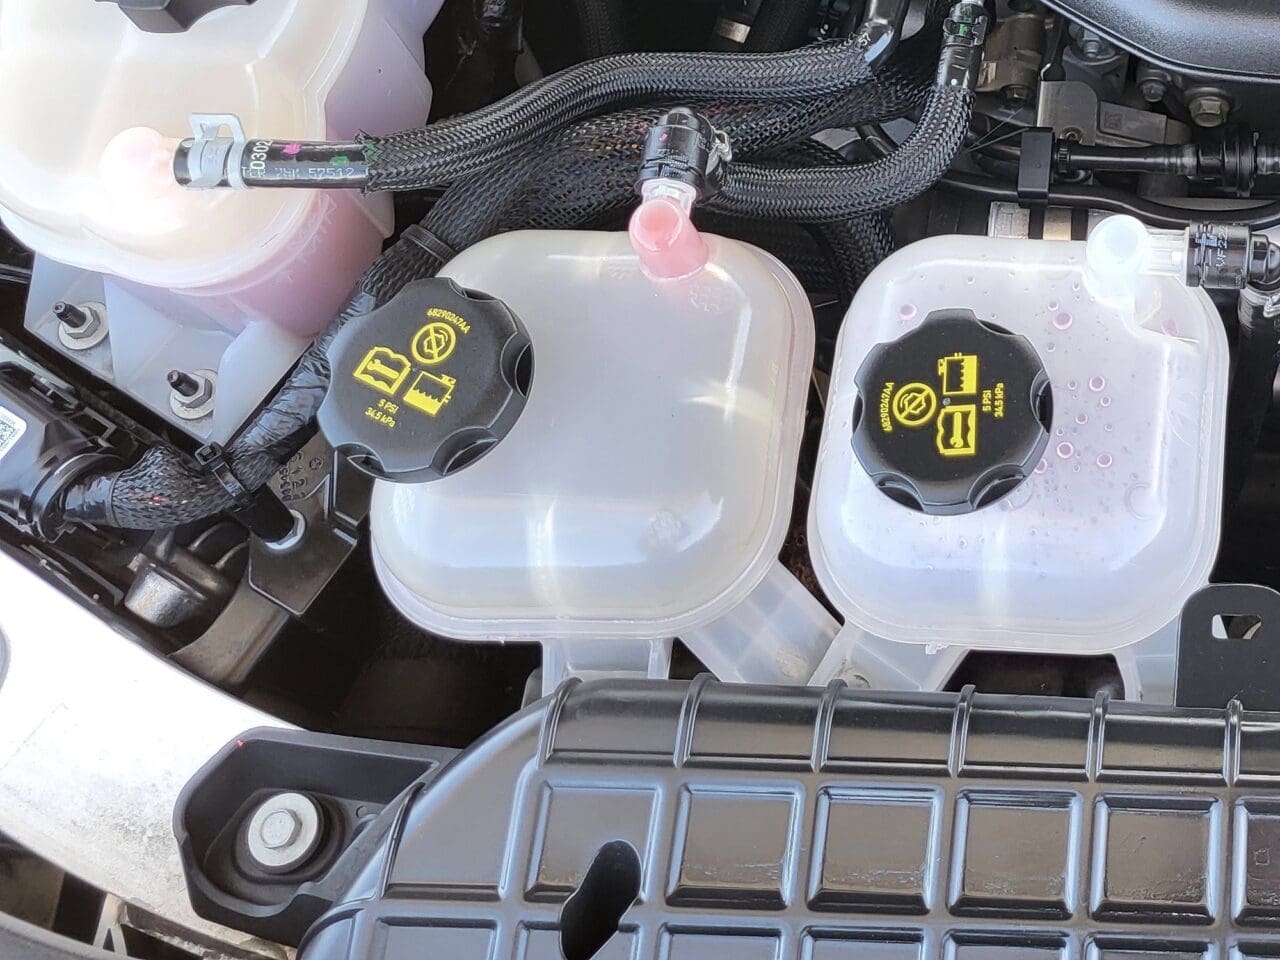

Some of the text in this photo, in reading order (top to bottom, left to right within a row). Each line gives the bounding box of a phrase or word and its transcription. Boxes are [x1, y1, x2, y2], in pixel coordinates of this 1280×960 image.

[426, 308, 471, 334] 68290247AA
[993, 381, 1004, 399] kPa
[377, 397, 399, 415] 5 PSI
[879, 382, 894, 431] 68290247AA
[981, 389, 992, 412] 5 PSI
[379, 413, 396, 427] kPa
